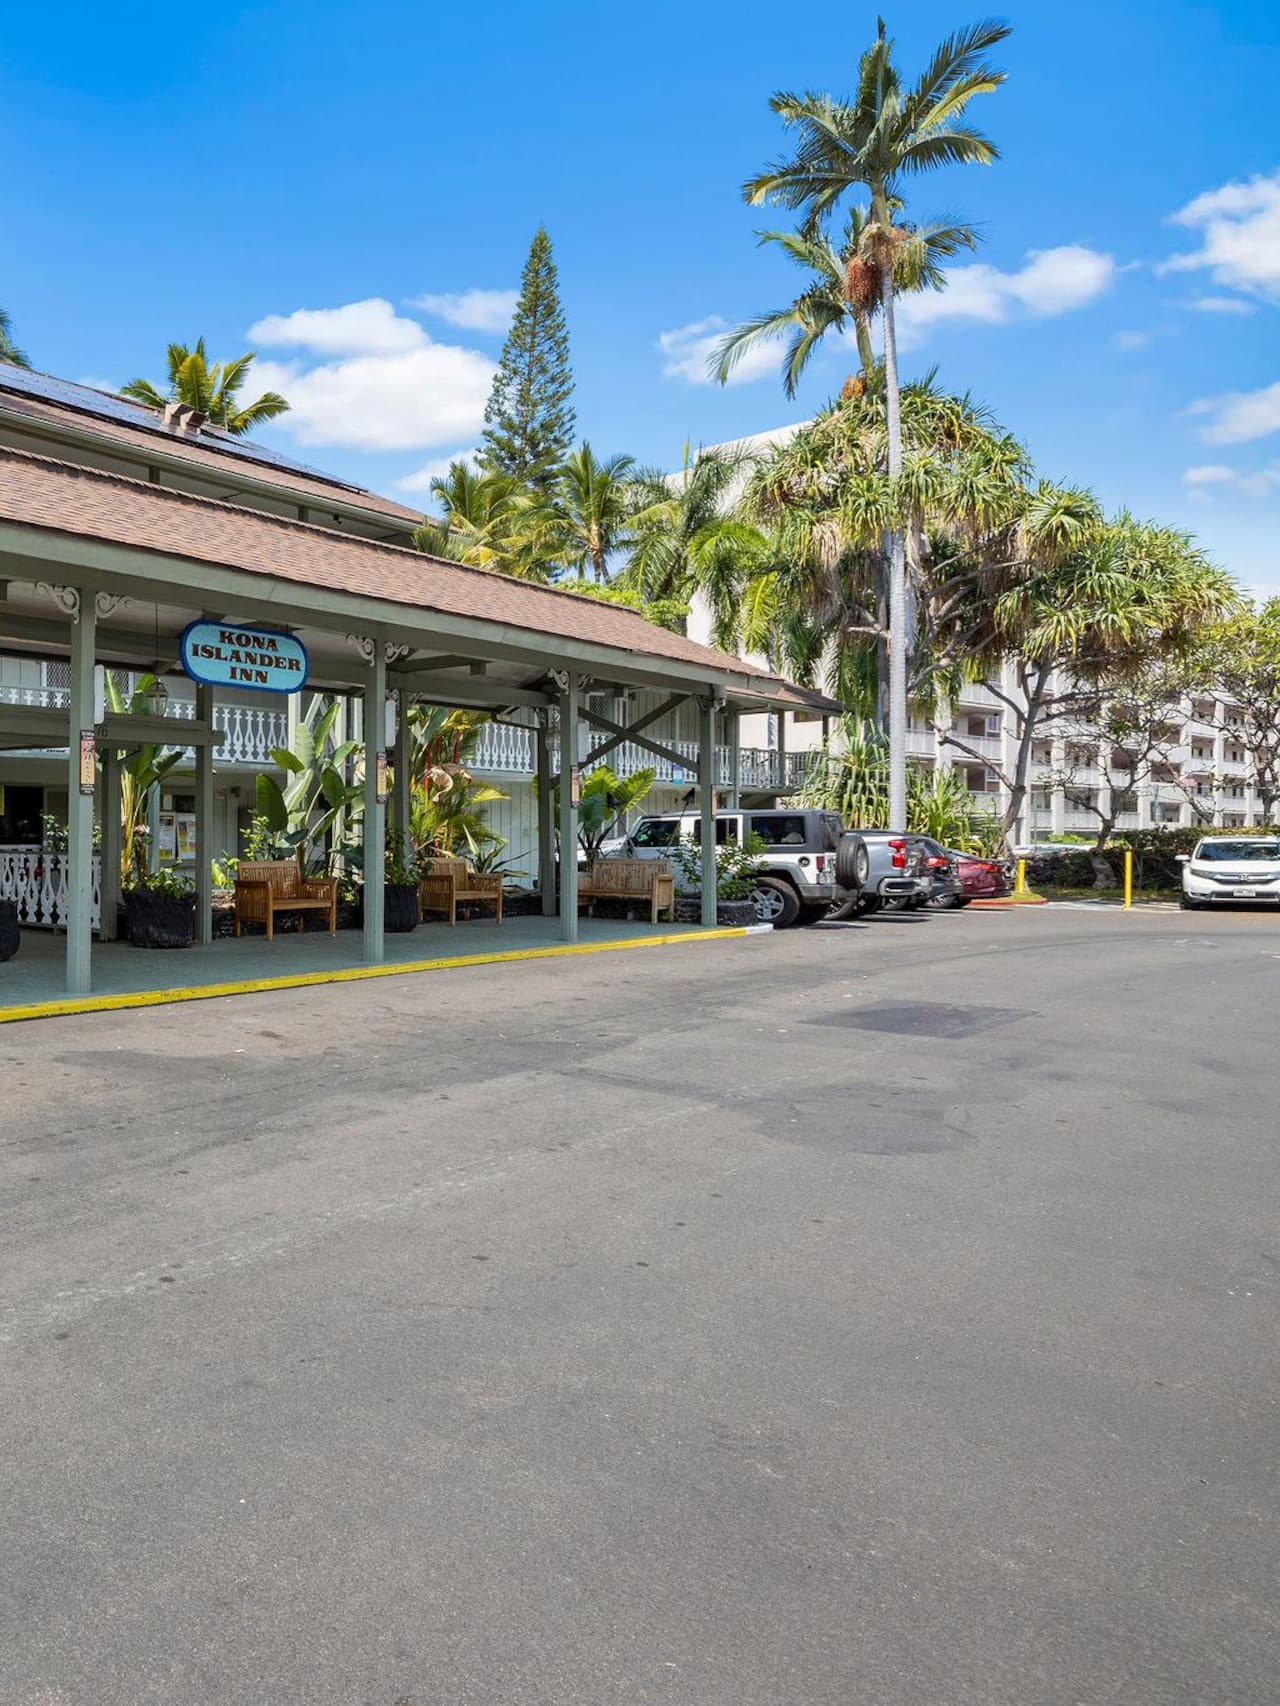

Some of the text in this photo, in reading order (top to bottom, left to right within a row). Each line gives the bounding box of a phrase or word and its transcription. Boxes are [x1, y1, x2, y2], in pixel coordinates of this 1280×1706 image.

[219, 630, 279, 652] KONA
[192, 643, 301, 671] ISLANDER
[230, 666, 270, 684] INN
